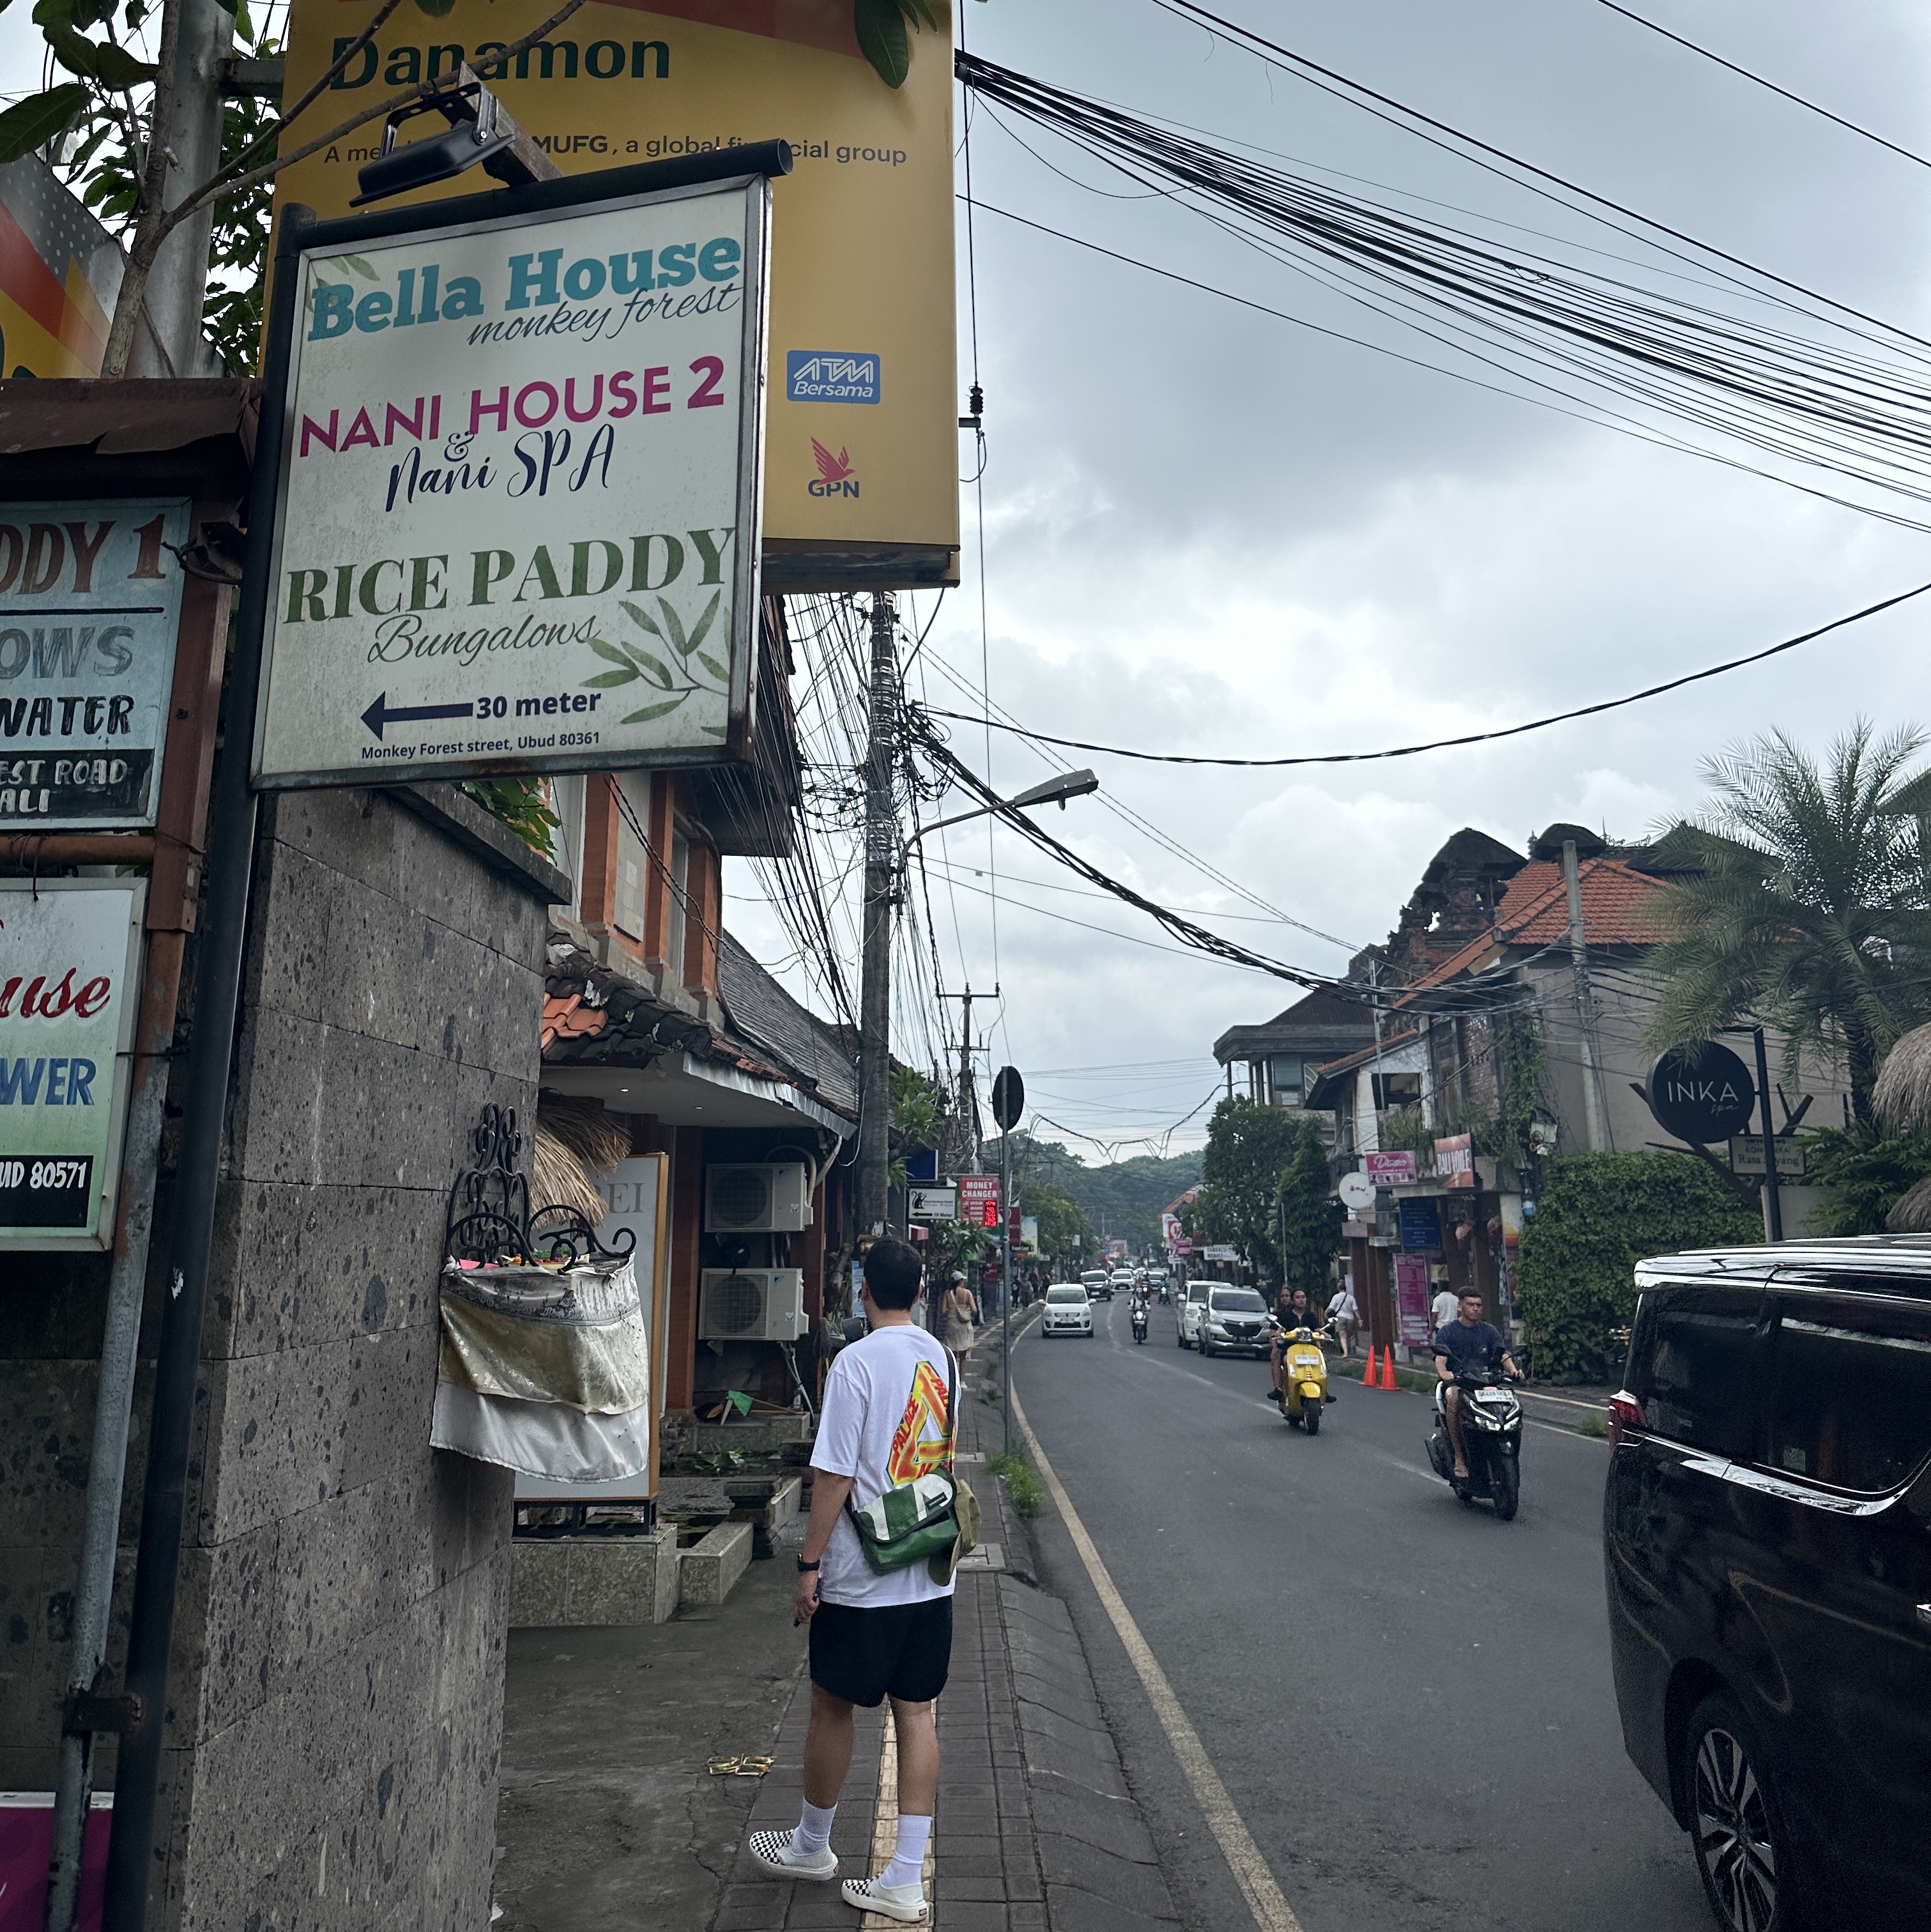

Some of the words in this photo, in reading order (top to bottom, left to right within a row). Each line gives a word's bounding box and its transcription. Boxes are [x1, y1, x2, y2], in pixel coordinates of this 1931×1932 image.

[330, 37, 670, 91] Danamon
[324, 146, 339, 163] A
[625, 140, 638, 153] a
[646, 135, 719, 157] global
[728, 137, 828, 158] ficial
[836, 146, 906, 166] group
[308, 265, 484, 341] Bella
[505, 237, 741, 313] House
[467, 301, 607, 346] monkey
[606, 283, 744, 339] forest
[794, 358, 873, 383] ATM
[794, 381, 873, 397] Bersama
[300, 395, 441, 457] NANI
[468, 366, 671, 435] HOUSE
[687, 355, 724, 409] 2
[444, 430, 475, 461] &
[385, 446, 497, 512] Nani
[507, 423, 616, 498] SPA
[808, 480, 859, 498] GPN
[128, 513, 166, 579] 1
[282, 554, 449, 625] RICE
[466, 528, 735, 607] PADDY
[0, 625, 134, 679] OWS
[367, 614, 601, 666] Bungalows
[476, 696, 507, 720] 30
[516, 690, 602, 717] meter
[361, 743, 416, 759] Monkey
[419, 740, 464, 755] Forest
[467, 736, 514, 754] street,
[517, 733, 556, 749] Ubud
[558, 731, 600, 747] 80361
[54, 759, 128, 784] ROAD
[0, 789, 50, 812] ALI
[0, 1058, 96, 1105] WER
[1668, 1081, 1739, 1102] INKA
[1711, 1104, 1739, 1117] spa
[1738, 1154, 1760, 1164] Rasa
[30, 1161, 87, 1189] 80571
[966, 1181, 993, 1189] MONEY
[931, 1377, 949, 1410] PAL
